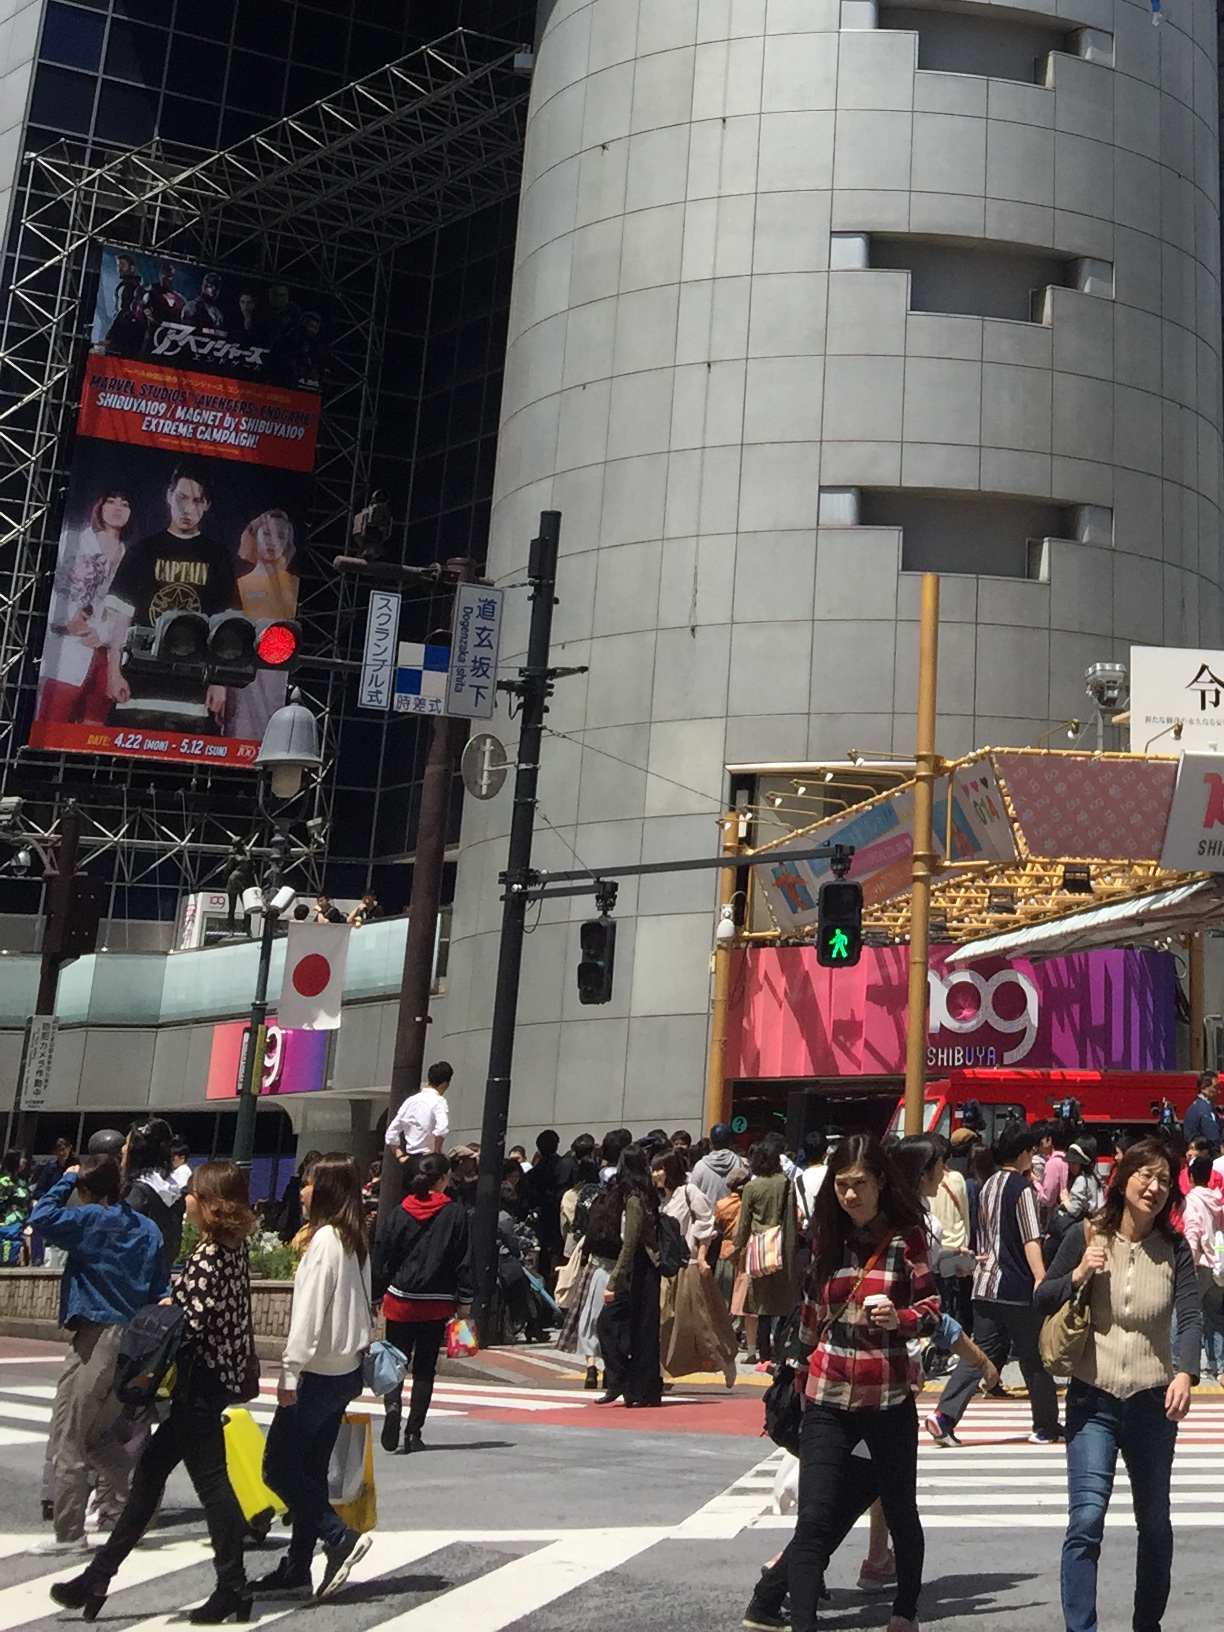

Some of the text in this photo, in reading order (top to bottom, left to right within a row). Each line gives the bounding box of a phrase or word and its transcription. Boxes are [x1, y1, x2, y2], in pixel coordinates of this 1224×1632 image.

[96, 391, 167, 418] SHIBUYA109
[175, 405, 223, 427] MAGNET
[223, 411, 238, 430] by
[239, 415, 305, 441] SHIBUYA109
[141, 416, 194, 440] EXTREME
[196, 426, 260, 450] CAMPAIGN!
[367, 597, 393, 705] スクランブル式
[454, 606, 473, 694] Dogenzaka shita
[468, 597, 498, 708] 道玄坂下
[396, 694, 442, 715] 時差式
[114, 732, 143, 750] 4.22
[180, 739, 203, 755] 5.12
[927, 969, 1039, 1065] 109
[927, 1046, 997, 1066] SHIBUYA
